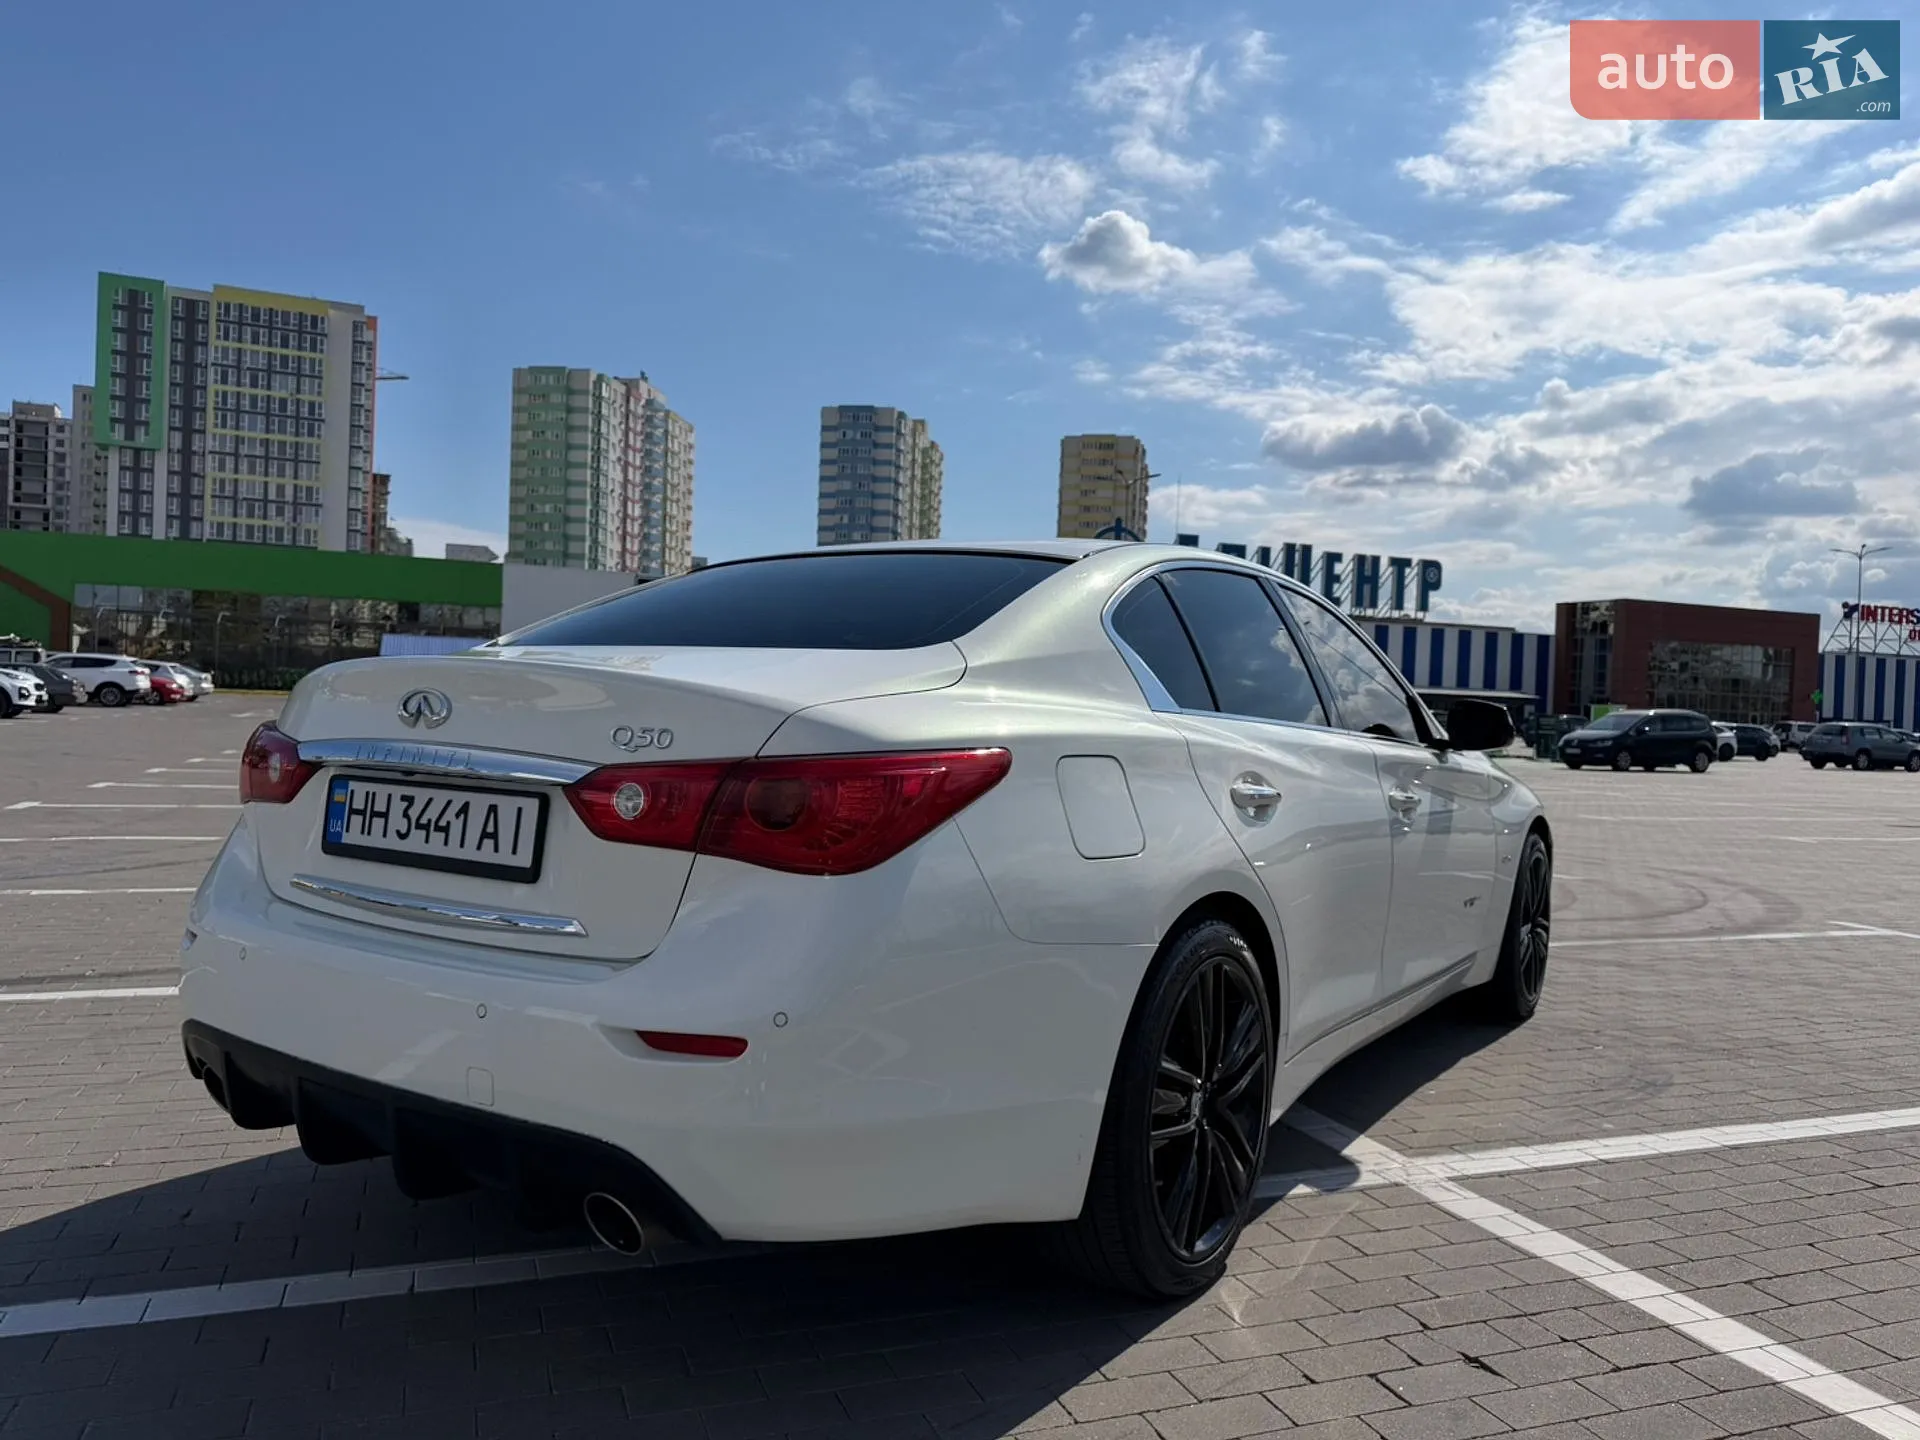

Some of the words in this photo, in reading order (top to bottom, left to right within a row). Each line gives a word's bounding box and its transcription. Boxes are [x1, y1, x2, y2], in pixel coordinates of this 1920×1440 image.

[609, 725, 674, 753] Q50
[355, 744, 473, 768] INFINITI
[329, 822, 343, 833] UA
